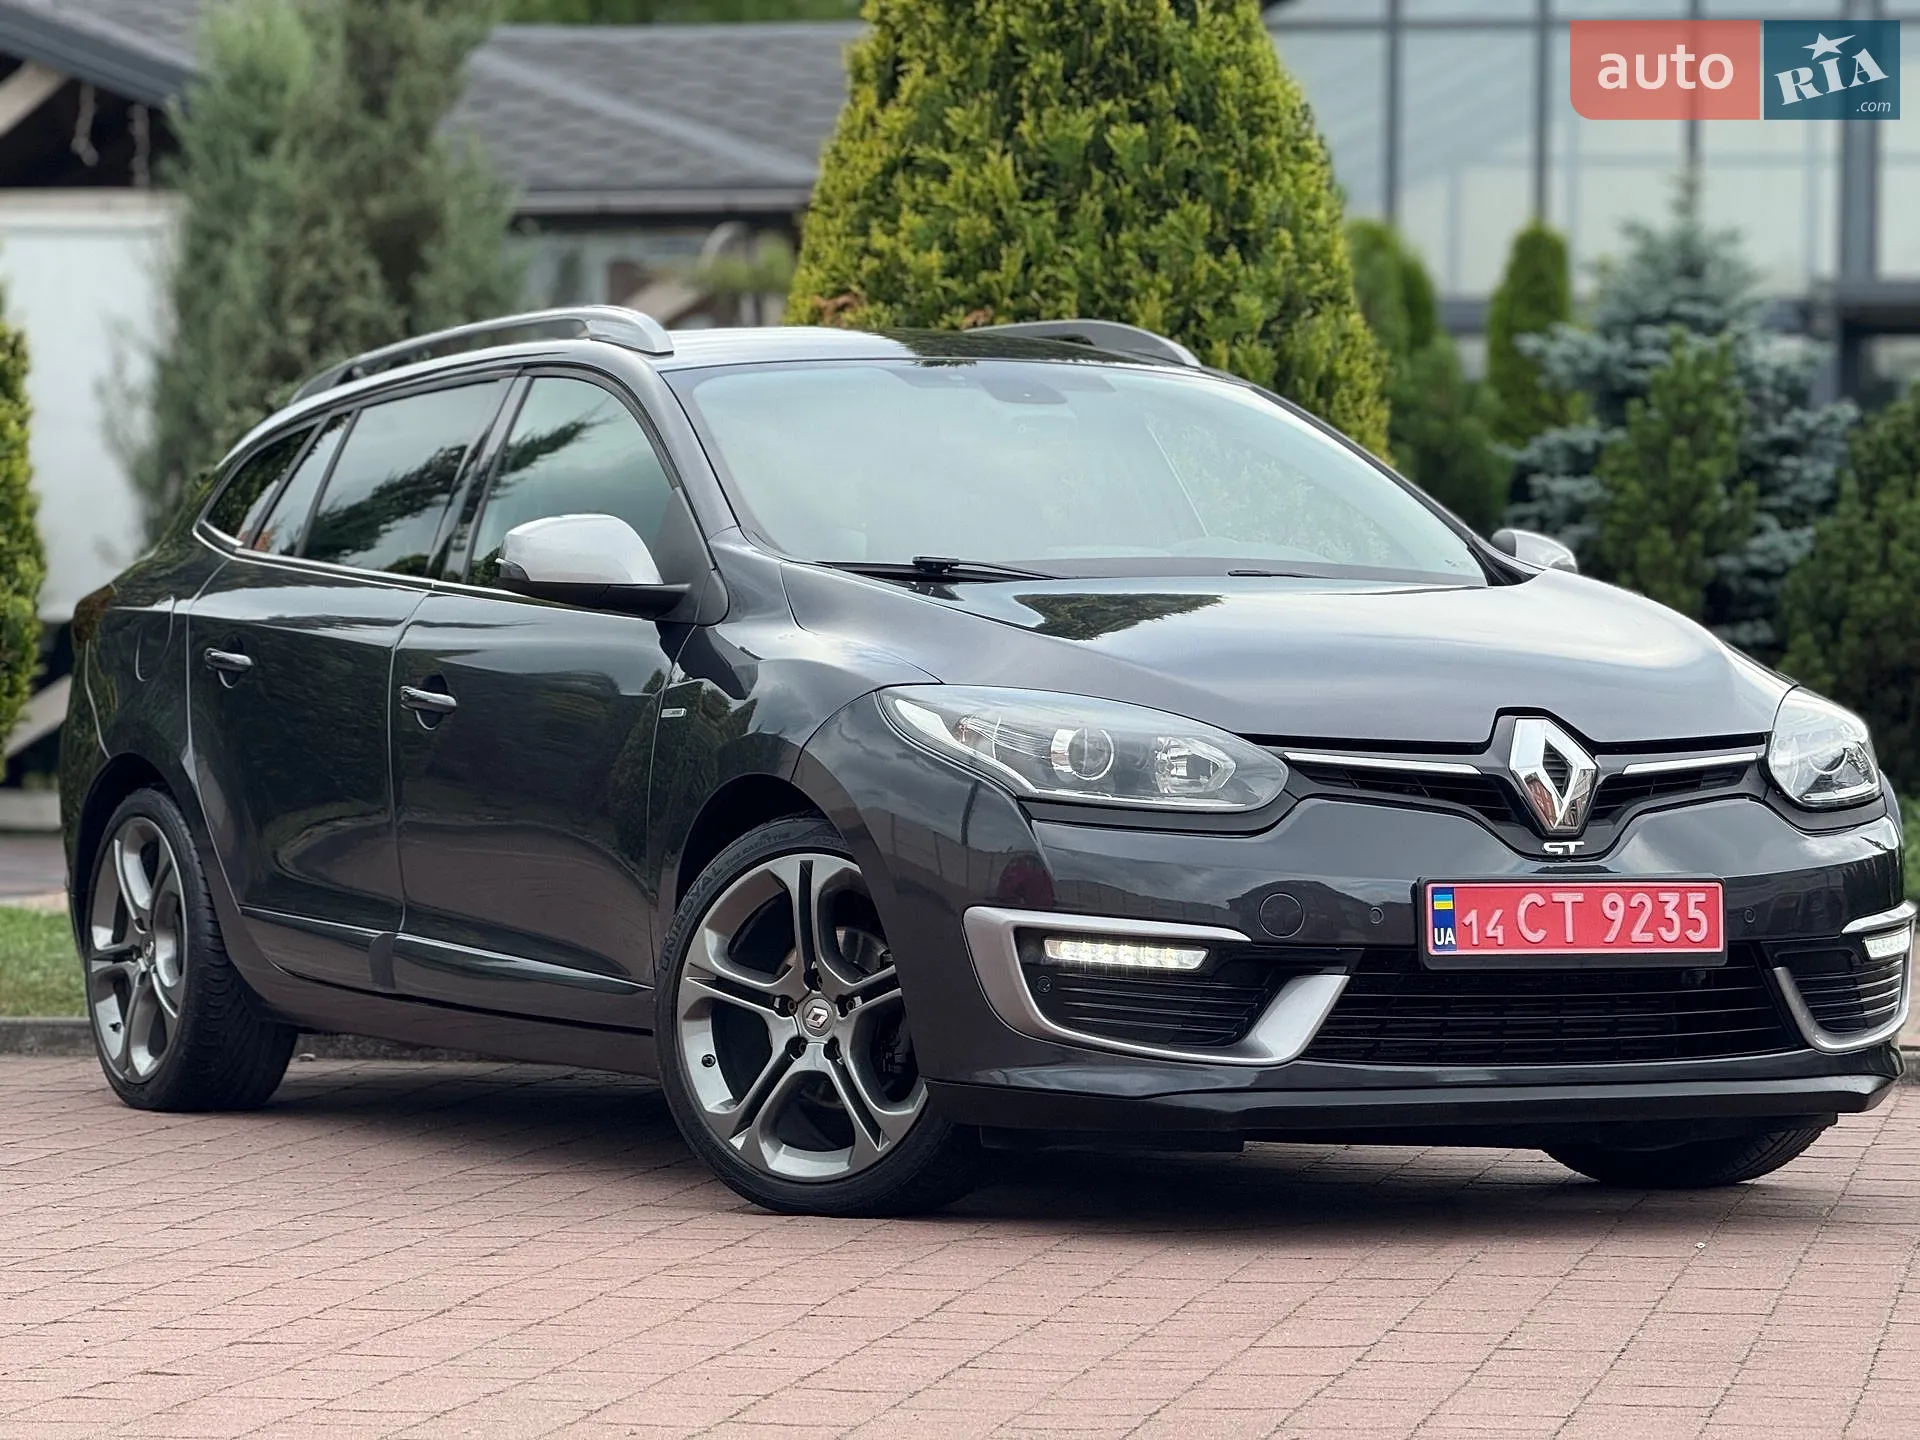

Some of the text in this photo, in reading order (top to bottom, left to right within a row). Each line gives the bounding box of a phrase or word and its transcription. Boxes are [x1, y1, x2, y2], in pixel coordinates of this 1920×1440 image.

[660, 865, 723, 972] UNIROYAL
[1434, 927, 1456, 946] UA
[1462, 892, 1708, 945] 14 CT 9235
